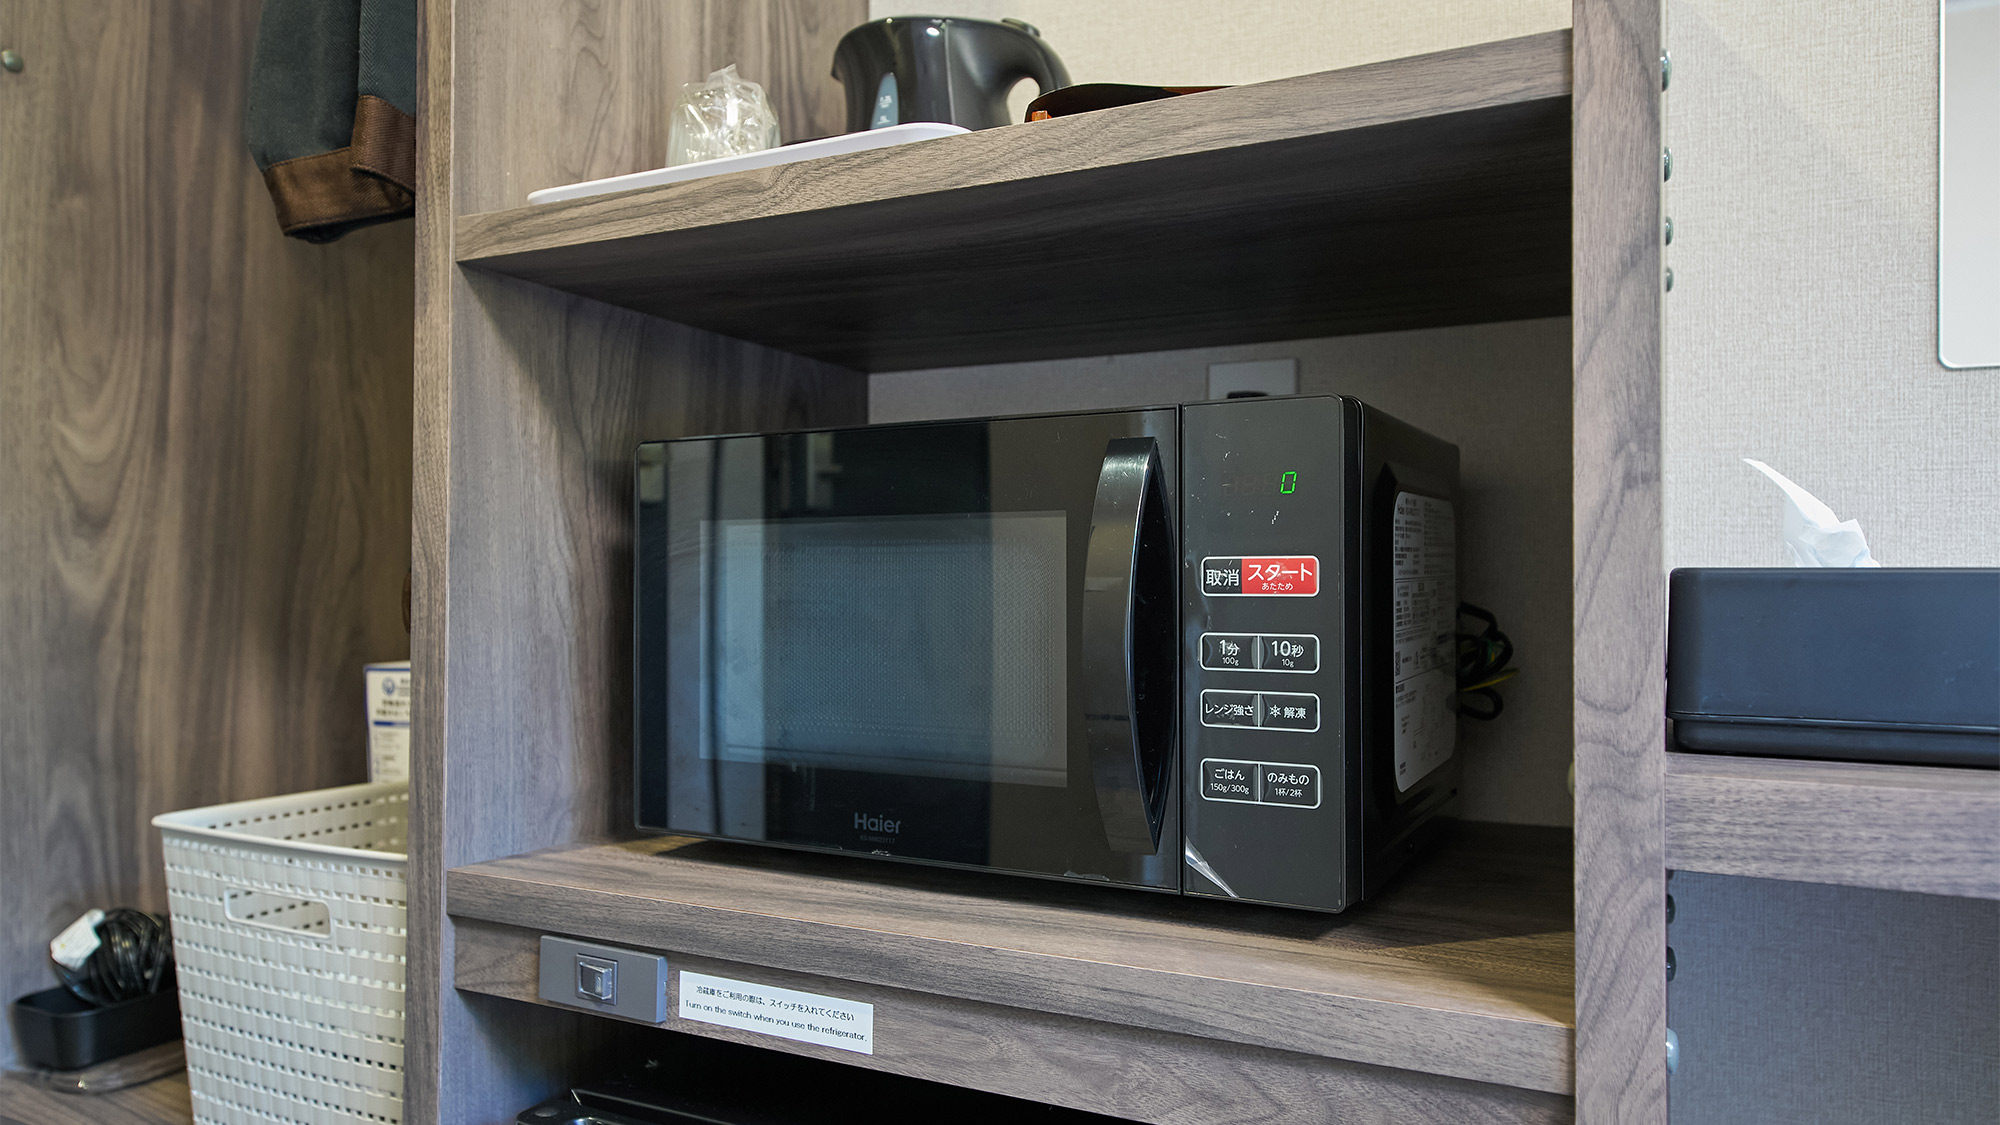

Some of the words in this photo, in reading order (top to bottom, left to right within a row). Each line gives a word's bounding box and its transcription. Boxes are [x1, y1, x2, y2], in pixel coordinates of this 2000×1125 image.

[1280, 471, 1297, 494] 0
[1205, 568, 1240, 587] 取消
[1247, 562, 1313, 582] スタート
[1261, 582, 1294, 591] あたため
[1219, 639, 1240, 656] 1分
[1271, 640, 1305, 658] 10秒
[1222, 657, 1240, 666] 100g
[1281, 658, 1295, 668] 10g
[1205, 703, 1254, 716] レンジ強さ
[1283, 706, 1307, 719] 解凍
[1214, 768, 1246, 781] ごはん
[1267, 772, 1310, 786] のみもの
[1210, 782, 1250, 795] 150g/300g
[1274, 787, 1303, 798] 1杯/2杯
[854, 812, 901, 834] Haier
[685, 999, 702, 1010] Turn
[703, 1003, 713, 1012] on
[714, 1005, 727, 1015] the
[728, 1009, 752, 1019] switch
[753, 1013, 774, 1023] when
[775, 1018, 790, 1027] you
[791, 1021, 806, 1029] use
[807, 1023, 820, 1033] the
[821, 1026, 868, 1042] refrigerator.
